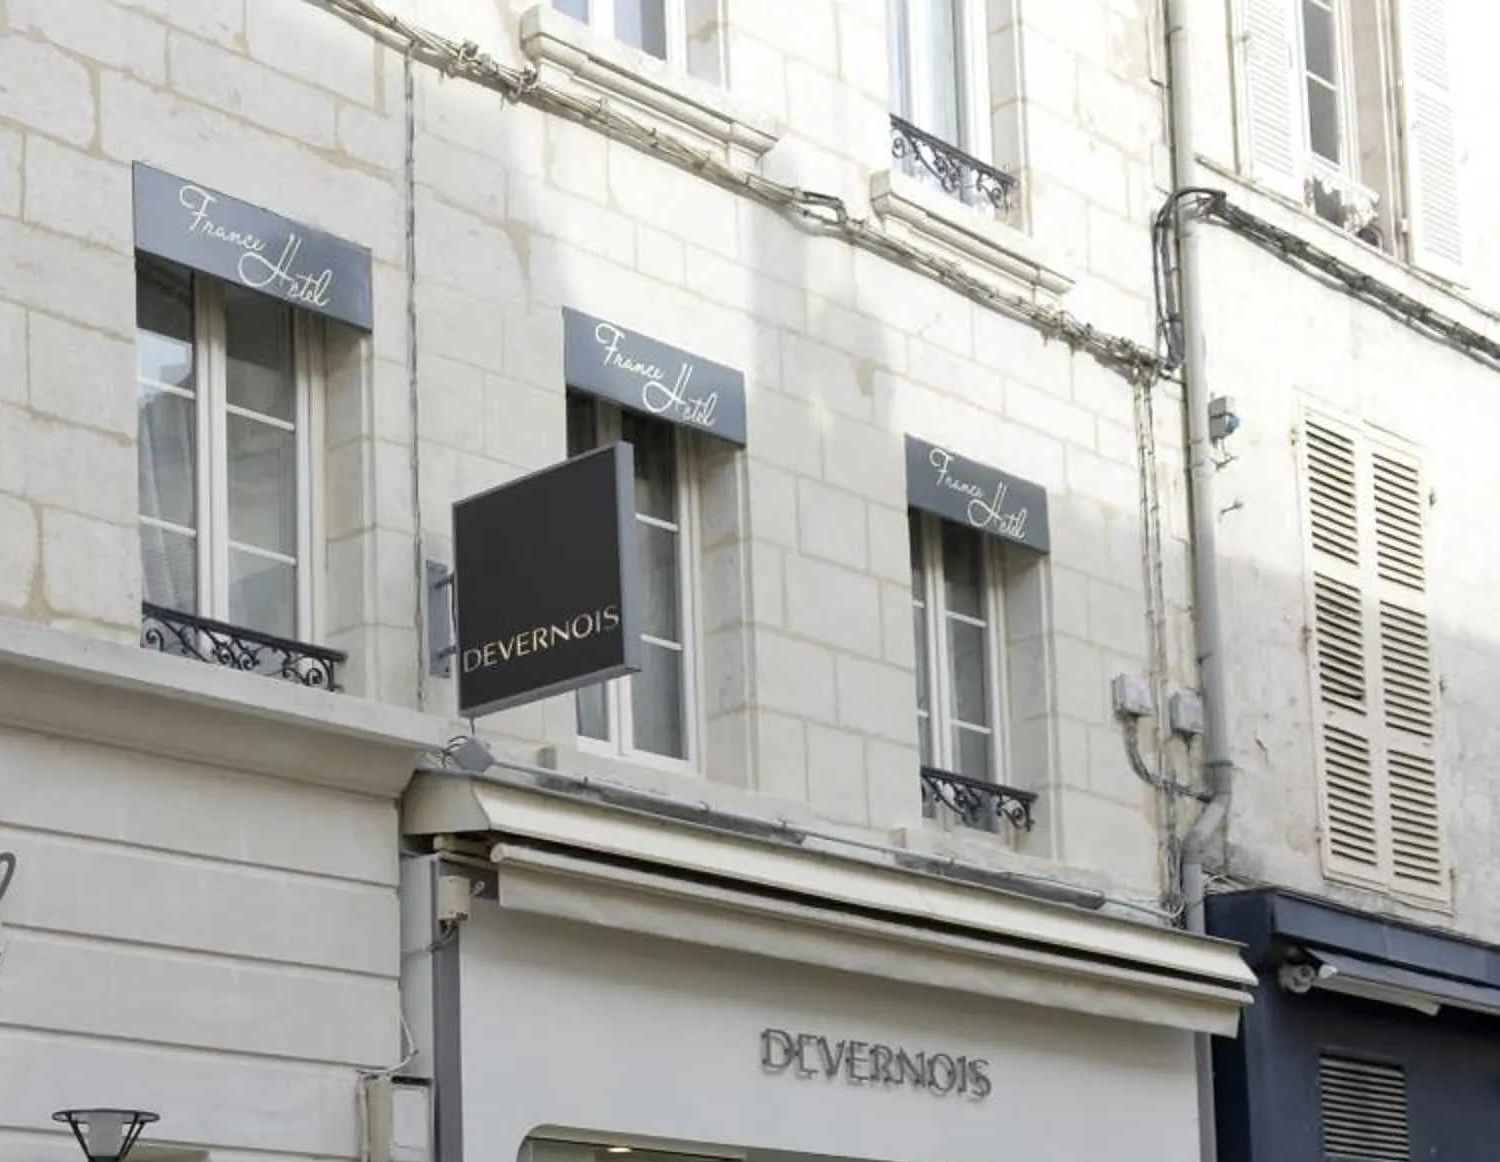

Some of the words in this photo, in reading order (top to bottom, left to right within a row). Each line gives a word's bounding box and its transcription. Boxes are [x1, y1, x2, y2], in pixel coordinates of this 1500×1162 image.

[179, 185, 266, 251] France
[595, 323, 665, 380] France
[462, 604, 620, 673] DEVERNOIS
[760, 1028, 993, 1098] DEVERNOIS
